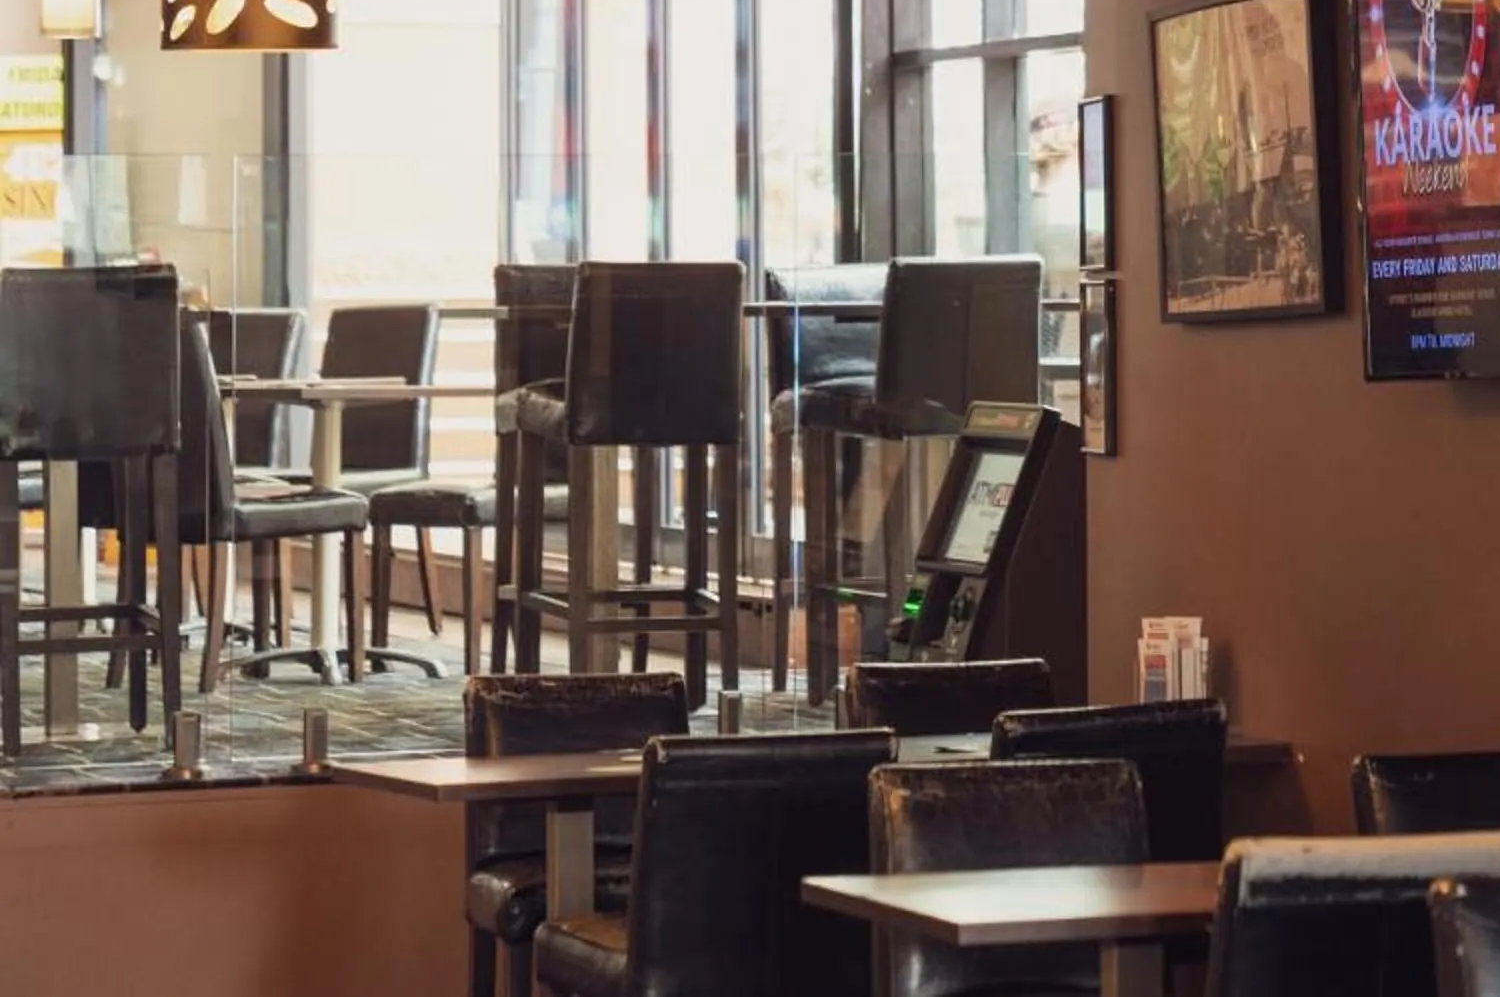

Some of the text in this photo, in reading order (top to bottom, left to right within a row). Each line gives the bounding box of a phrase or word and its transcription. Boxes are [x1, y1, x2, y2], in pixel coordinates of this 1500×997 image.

[1374, 95, 1497, 166] KARAOKE
[1373, 259, 1401, 280] EVERY
[1403, 257, 1436, 277] FRIDAY
[1437, 255, 1459, 275] AND
